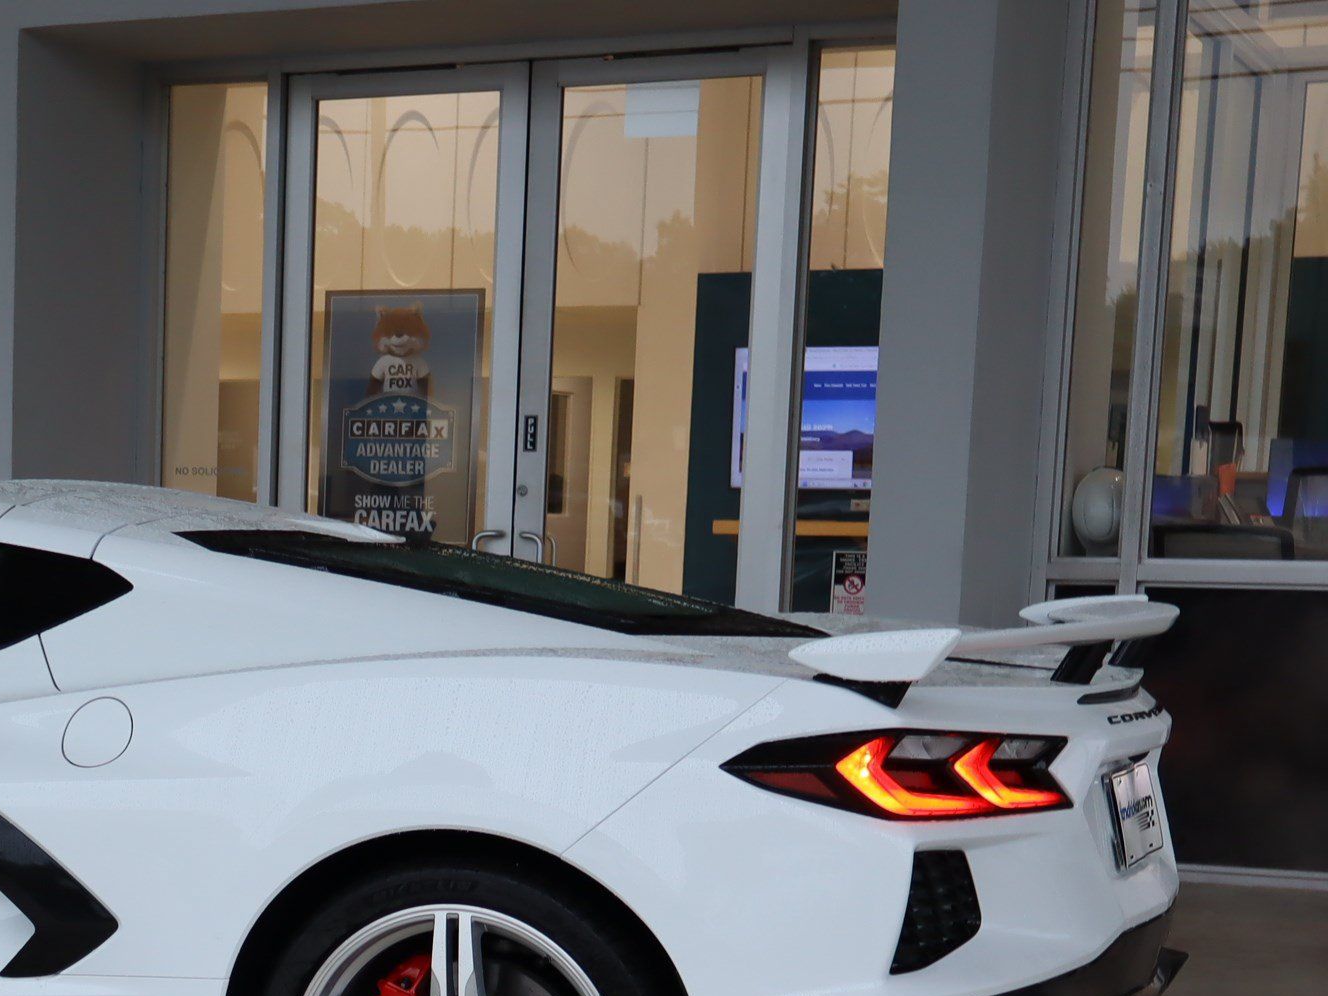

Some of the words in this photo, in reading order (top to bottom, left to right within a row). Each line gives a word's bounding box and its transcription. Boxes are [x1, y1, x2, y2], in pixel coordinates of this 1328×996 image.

[388, 364, 414, 377] CAR
[389, 377, 413, 389] FOX
[351, 421, 446, 439] CARFAX
[356, 443, 440, 458] ADVANTAGE
[175, 466, 189, 476] NO
[370, 460, 424, 475] DEALER
[354, 494, 391, 508] SHOW
[393, 495, 411, 509] ME
[413, 496, 434, 510] THE
[353, 509, 435, 532] CARFAX
